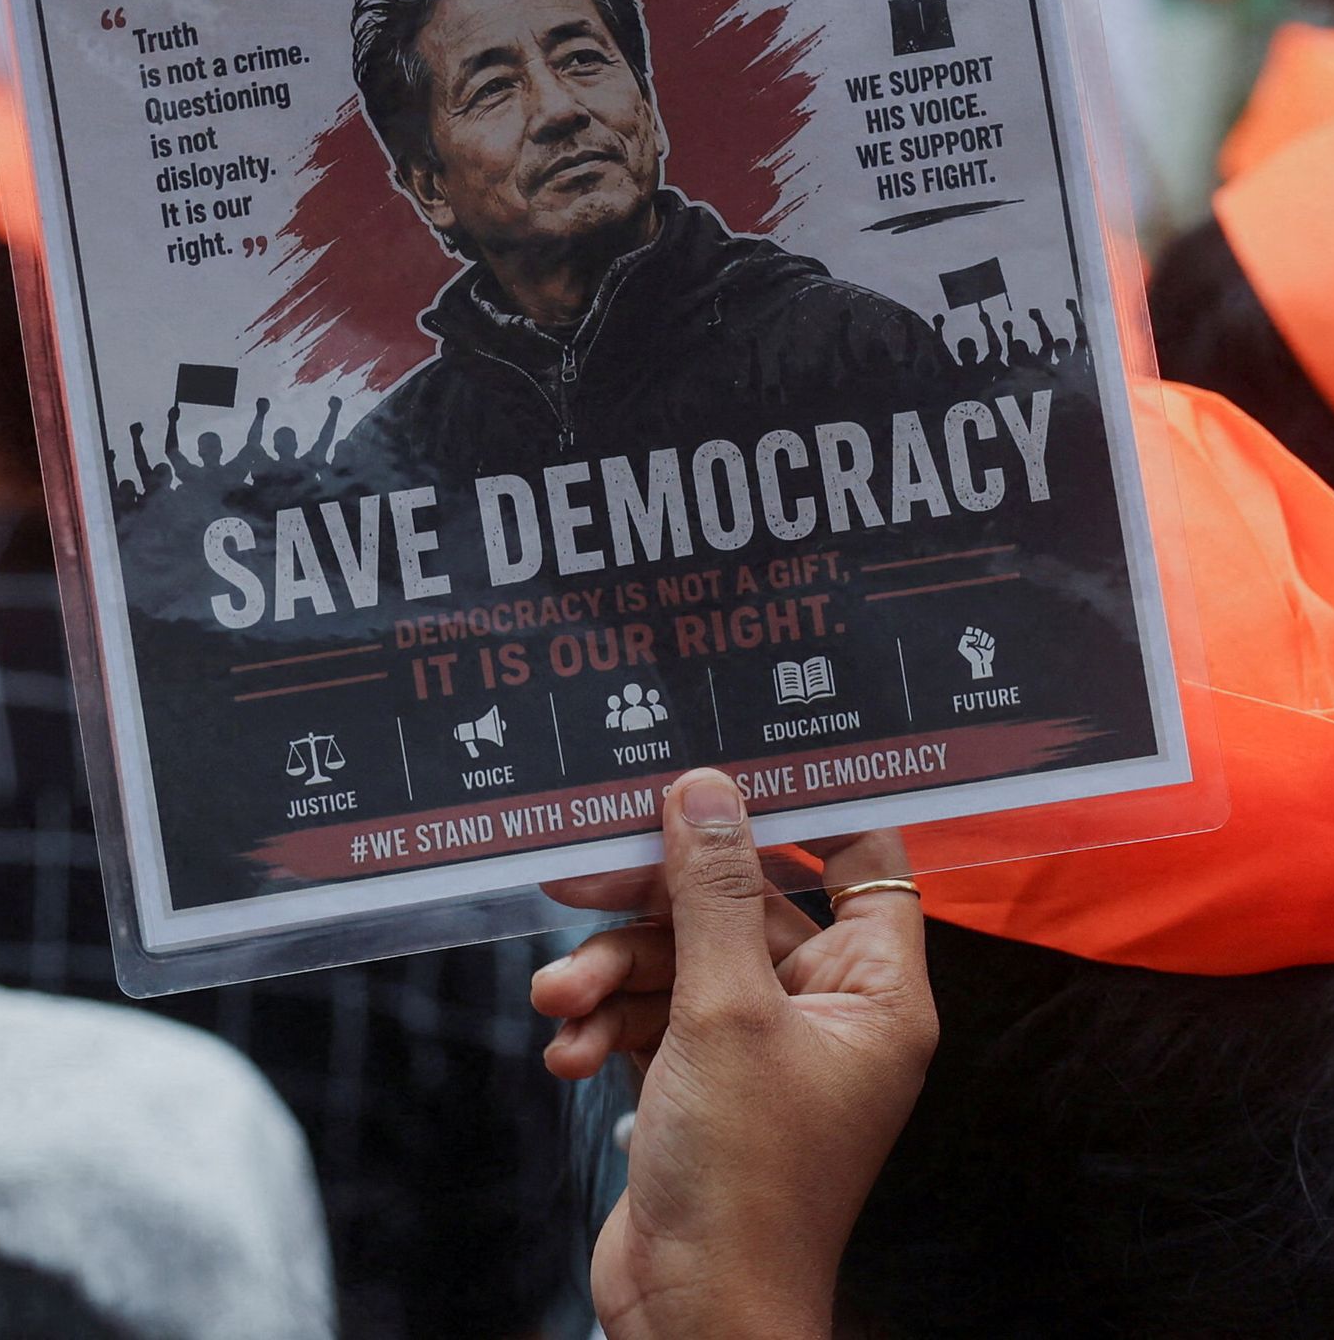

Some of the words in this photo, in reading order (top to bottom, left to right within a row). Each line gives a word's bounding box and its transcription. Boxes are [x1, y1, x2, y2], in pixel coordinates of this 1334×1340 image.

[139, 64, 161, 88] is
[167, 57, 207, 85] not
[213, 57, 227, 77] a
[233, 45, 310, 74] crime.
[845, 74, 884, 103] WE
[888, 56, 993, 96] SUPPORT
[145, 82, 291, 125] Questioning
[865, 105, 905, 134] HIS
[910, 93, 987, 126] VOICE.
[150, 134, 172, 159] is
[178, 127, 218, 155] not
[856, 141, 895, 169] WE
[899, 124, 1004, 162] SUPPORT
[156, 155, 277, 193] disloyalty.
[877, 171, 916, 201] HIS
[922, 159, 996, 193] FIGHT.
[161, 203, 181, 228] It
[185, 199, 207, 224] is
[213, 195, 253, 220] our
[203, 486, 451, 630] SAVE
[474, 389, 1053, 587] DEMOCRACY
[394, 588, 602, 649] DEMOCRACY
[616, 583, 646, 614] IS
[658, 570, 721, 606] NOT
[736, 565, 759, 593] A
[768, 551, 850, 589] GIFT,
[411, 653, 458, 700] IT
[480, 642, 531, 689] IS
[550, 624, 657, 677] OUR
[674, 594, 846, 658] RIGHT.
[953, 686, 1021, 713] FUTURE
[763, 711, 861, 742] EDUCATION
[613, 741, 671, 766] YOUTH
[461, 765, 515, 790] VOICE
[286, 791, 358, 819] JUSTICE
[351, 829, 408, 864] #WE
[416, 815, 494, 852] STAND
[501, 804, 564, 839] WITH
[571, 790, 655, 828] SONAM
[736, 766, 797, 801] SAVE
[804, 742, 948, 791] DEMOCRACY
